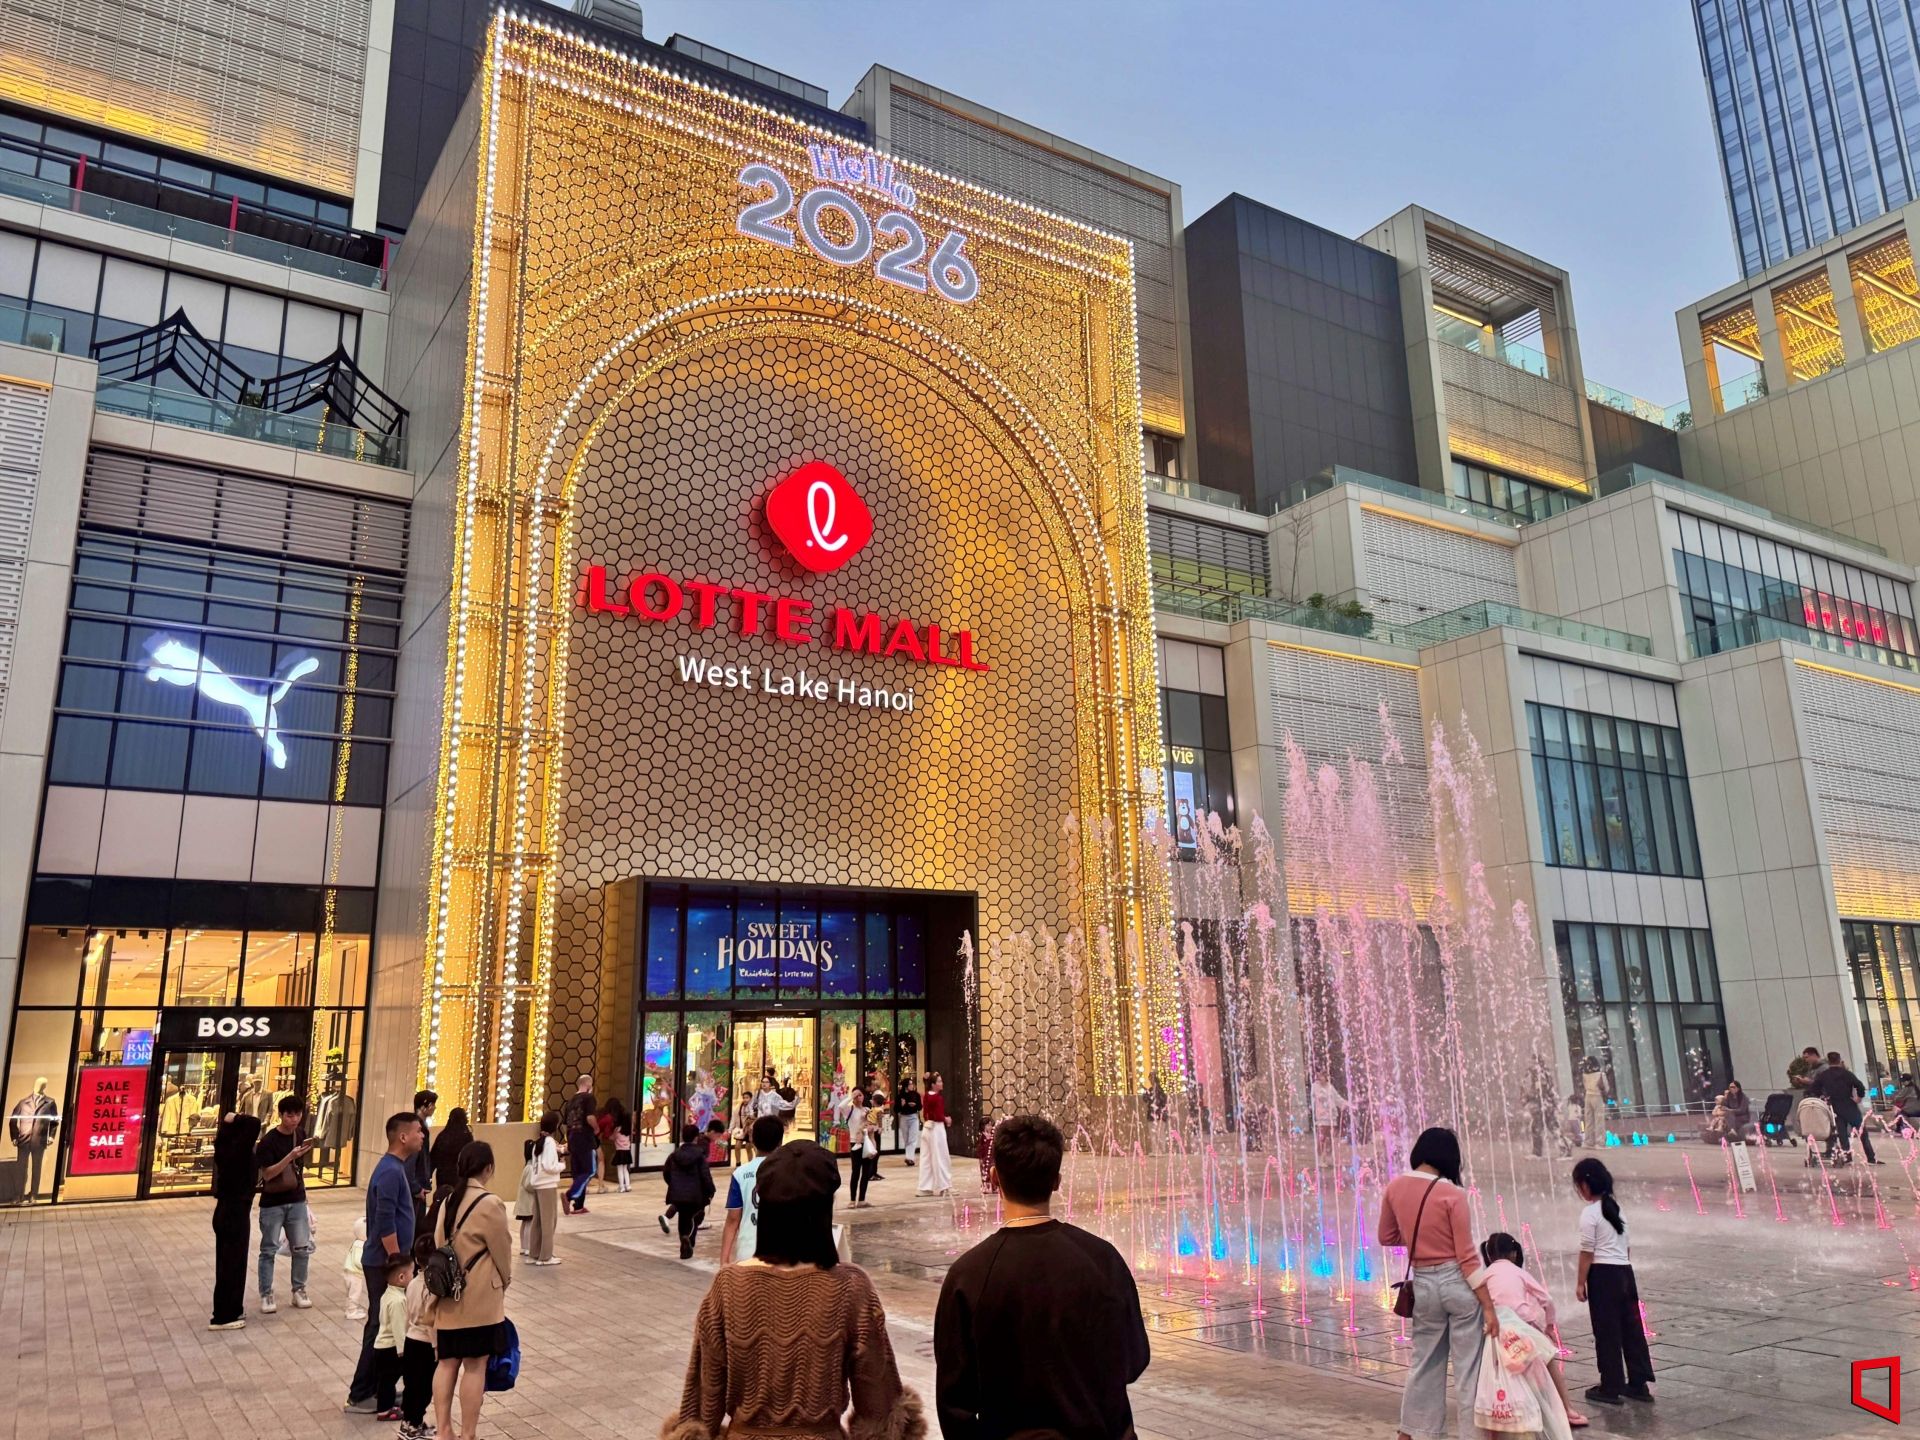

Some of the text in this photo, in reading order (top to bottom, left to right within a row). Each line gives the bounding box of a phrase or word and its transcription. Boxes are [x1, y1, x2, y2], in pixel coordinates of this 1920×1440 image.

[807, 143, 917, 210] Hello
[736, 161, 980, 305] 2026
[587, 565, 991, 672] LOTTE MALL
[678, 655, 915, 713] West Lake Hanoi
[1171, 749, 1195, 765] vie
[747, 922, 811, 940] SWEET
[717, 937, 833, 972] HOLIDAYS
[197, 1016, 271, 1038] BOSS
[96, 1081, 131, 1092] SALE
[94, 1094, 129, 1105] SALE
[93, 1108, 127, 1119] SALE
[91, 1122, 125, 1133] SALE
[89, 1134, 125, 1147] SALE
[88, 1149, 122, 1160] SALE
